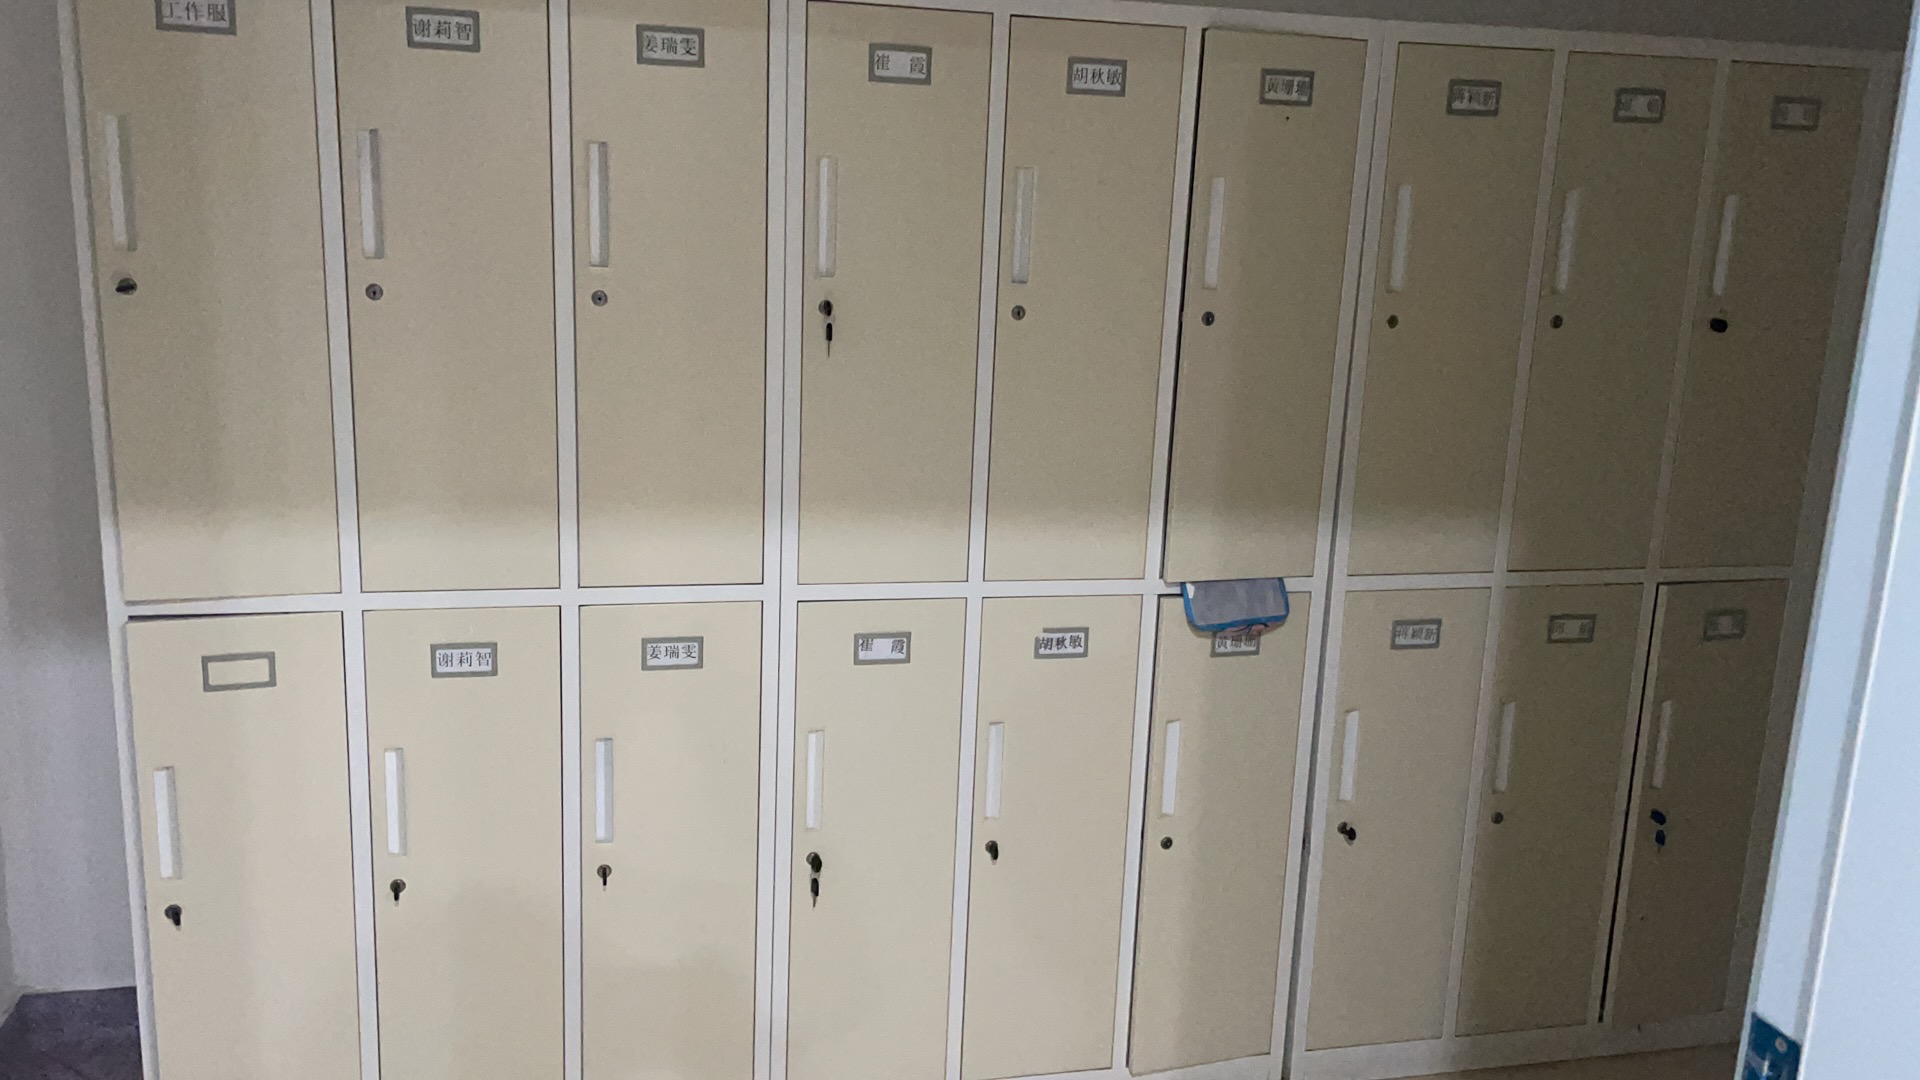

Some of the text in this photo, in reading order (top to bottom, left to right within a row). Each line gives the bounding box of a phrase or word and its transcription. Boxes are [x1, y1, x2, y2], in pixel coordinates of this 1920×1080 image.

[162, 1, 227, 22] 工作服
[413, 18, 471, 41] 谢莉智
[645, 35, 697, 56] 姜瑞雯
[1073, 67, 1121, 86] 胡秋敏
[647, 644, 697, 660] 姜瑞雯
[1039, 636, 1083, 653] 胡秋敏
[437, 651, 491, 668] 谢莉智
